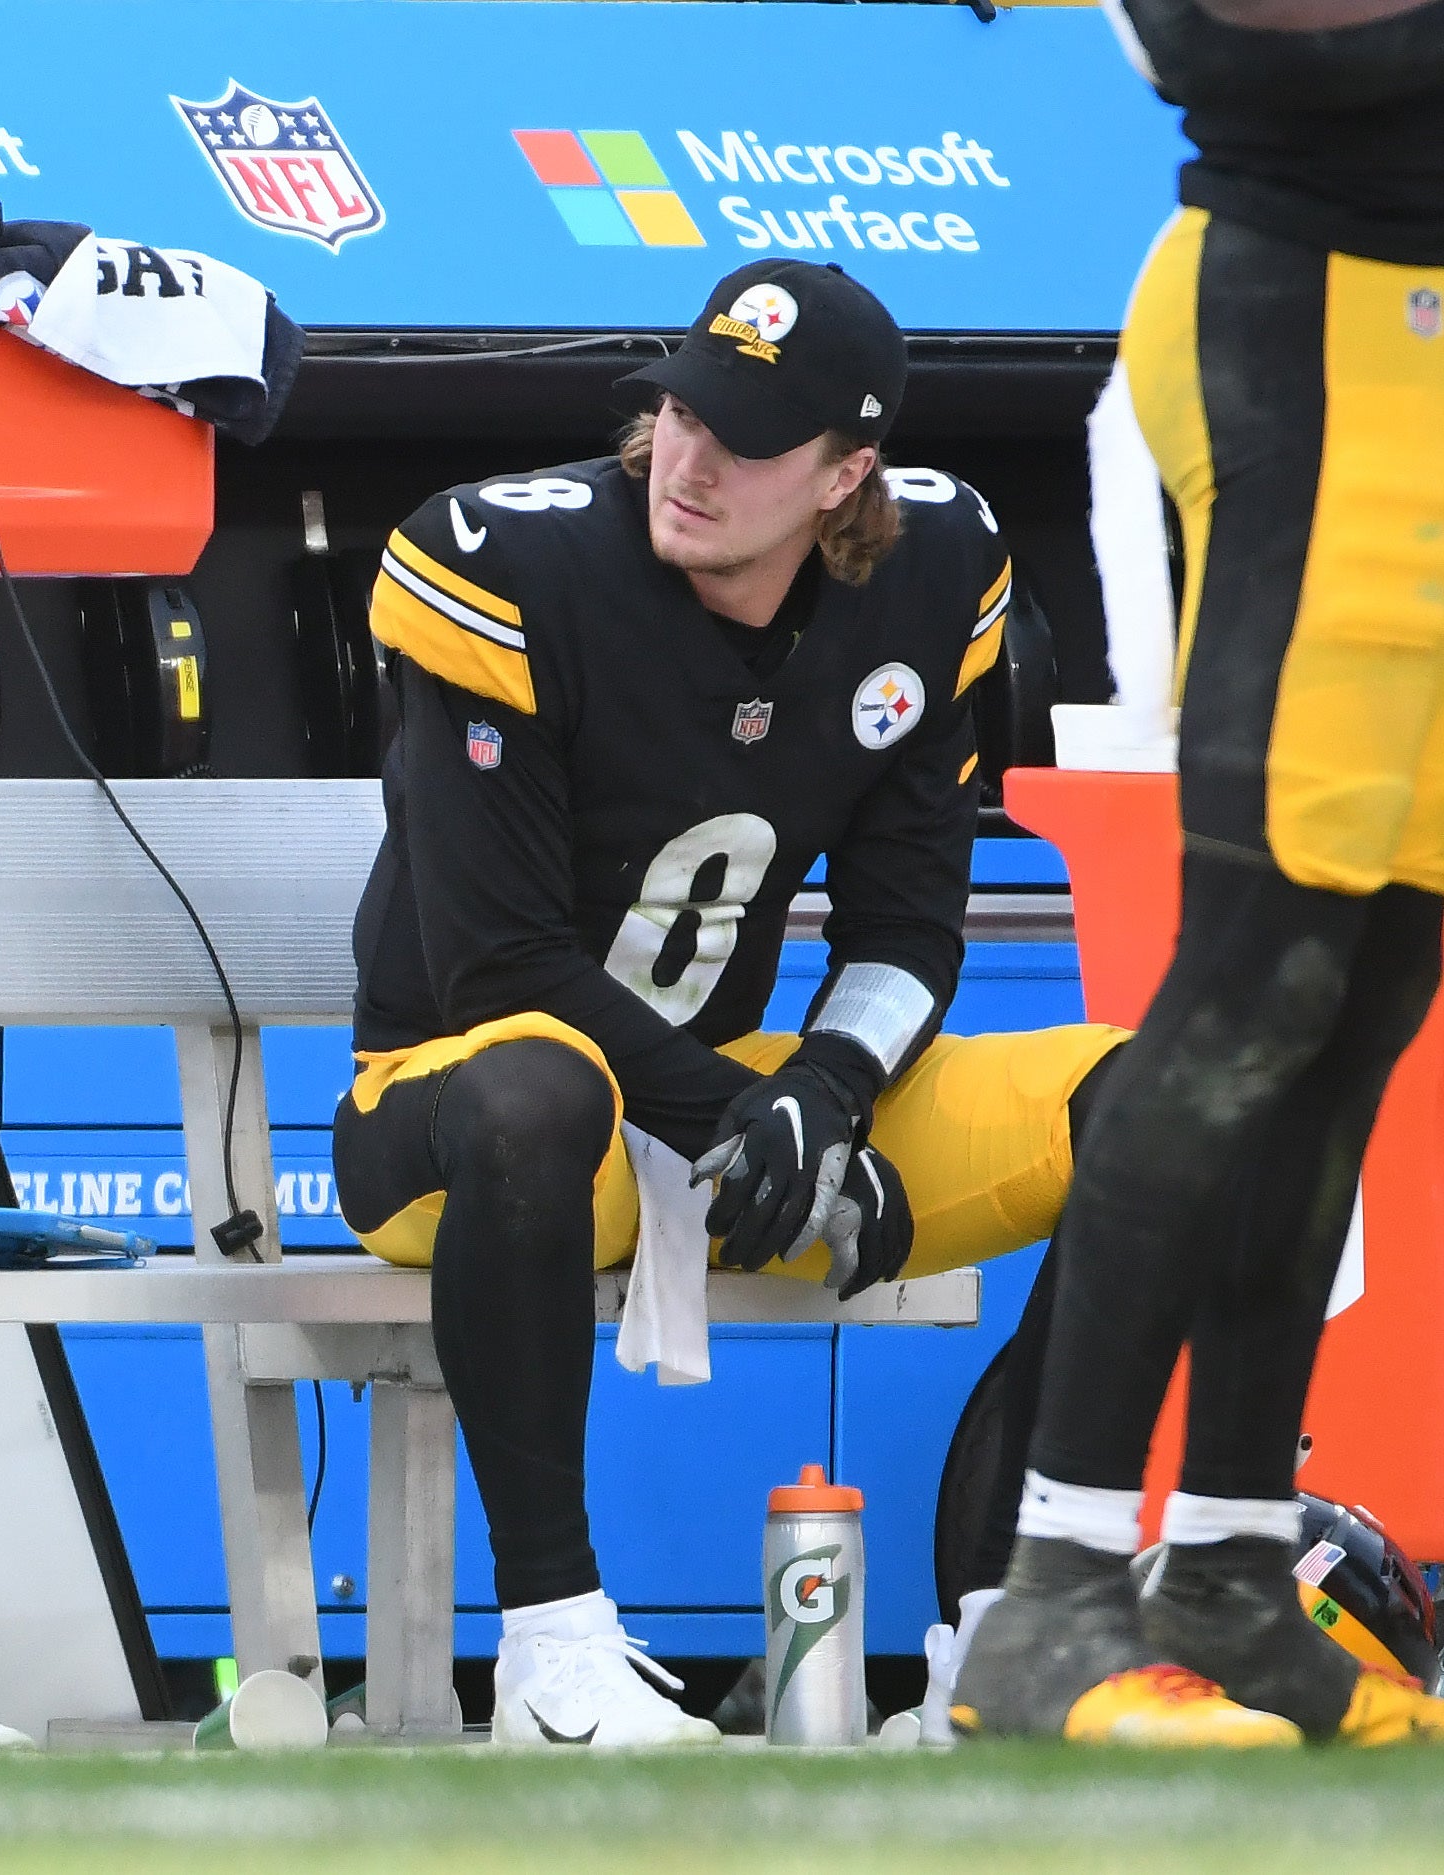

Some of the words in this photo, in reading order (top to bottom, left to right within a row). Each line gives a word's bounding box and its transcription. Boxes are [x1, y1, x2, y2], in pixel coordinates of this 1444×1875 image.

[676, 129, 1011, 187] Microsoft
[225, 156, 366, 226] NFL
[718, 195, 981, 252] Surface
[478, 478, 593, 512] 8
[603, 812, 778, 1018] 8
[779, 1557, 835, 1624] G
